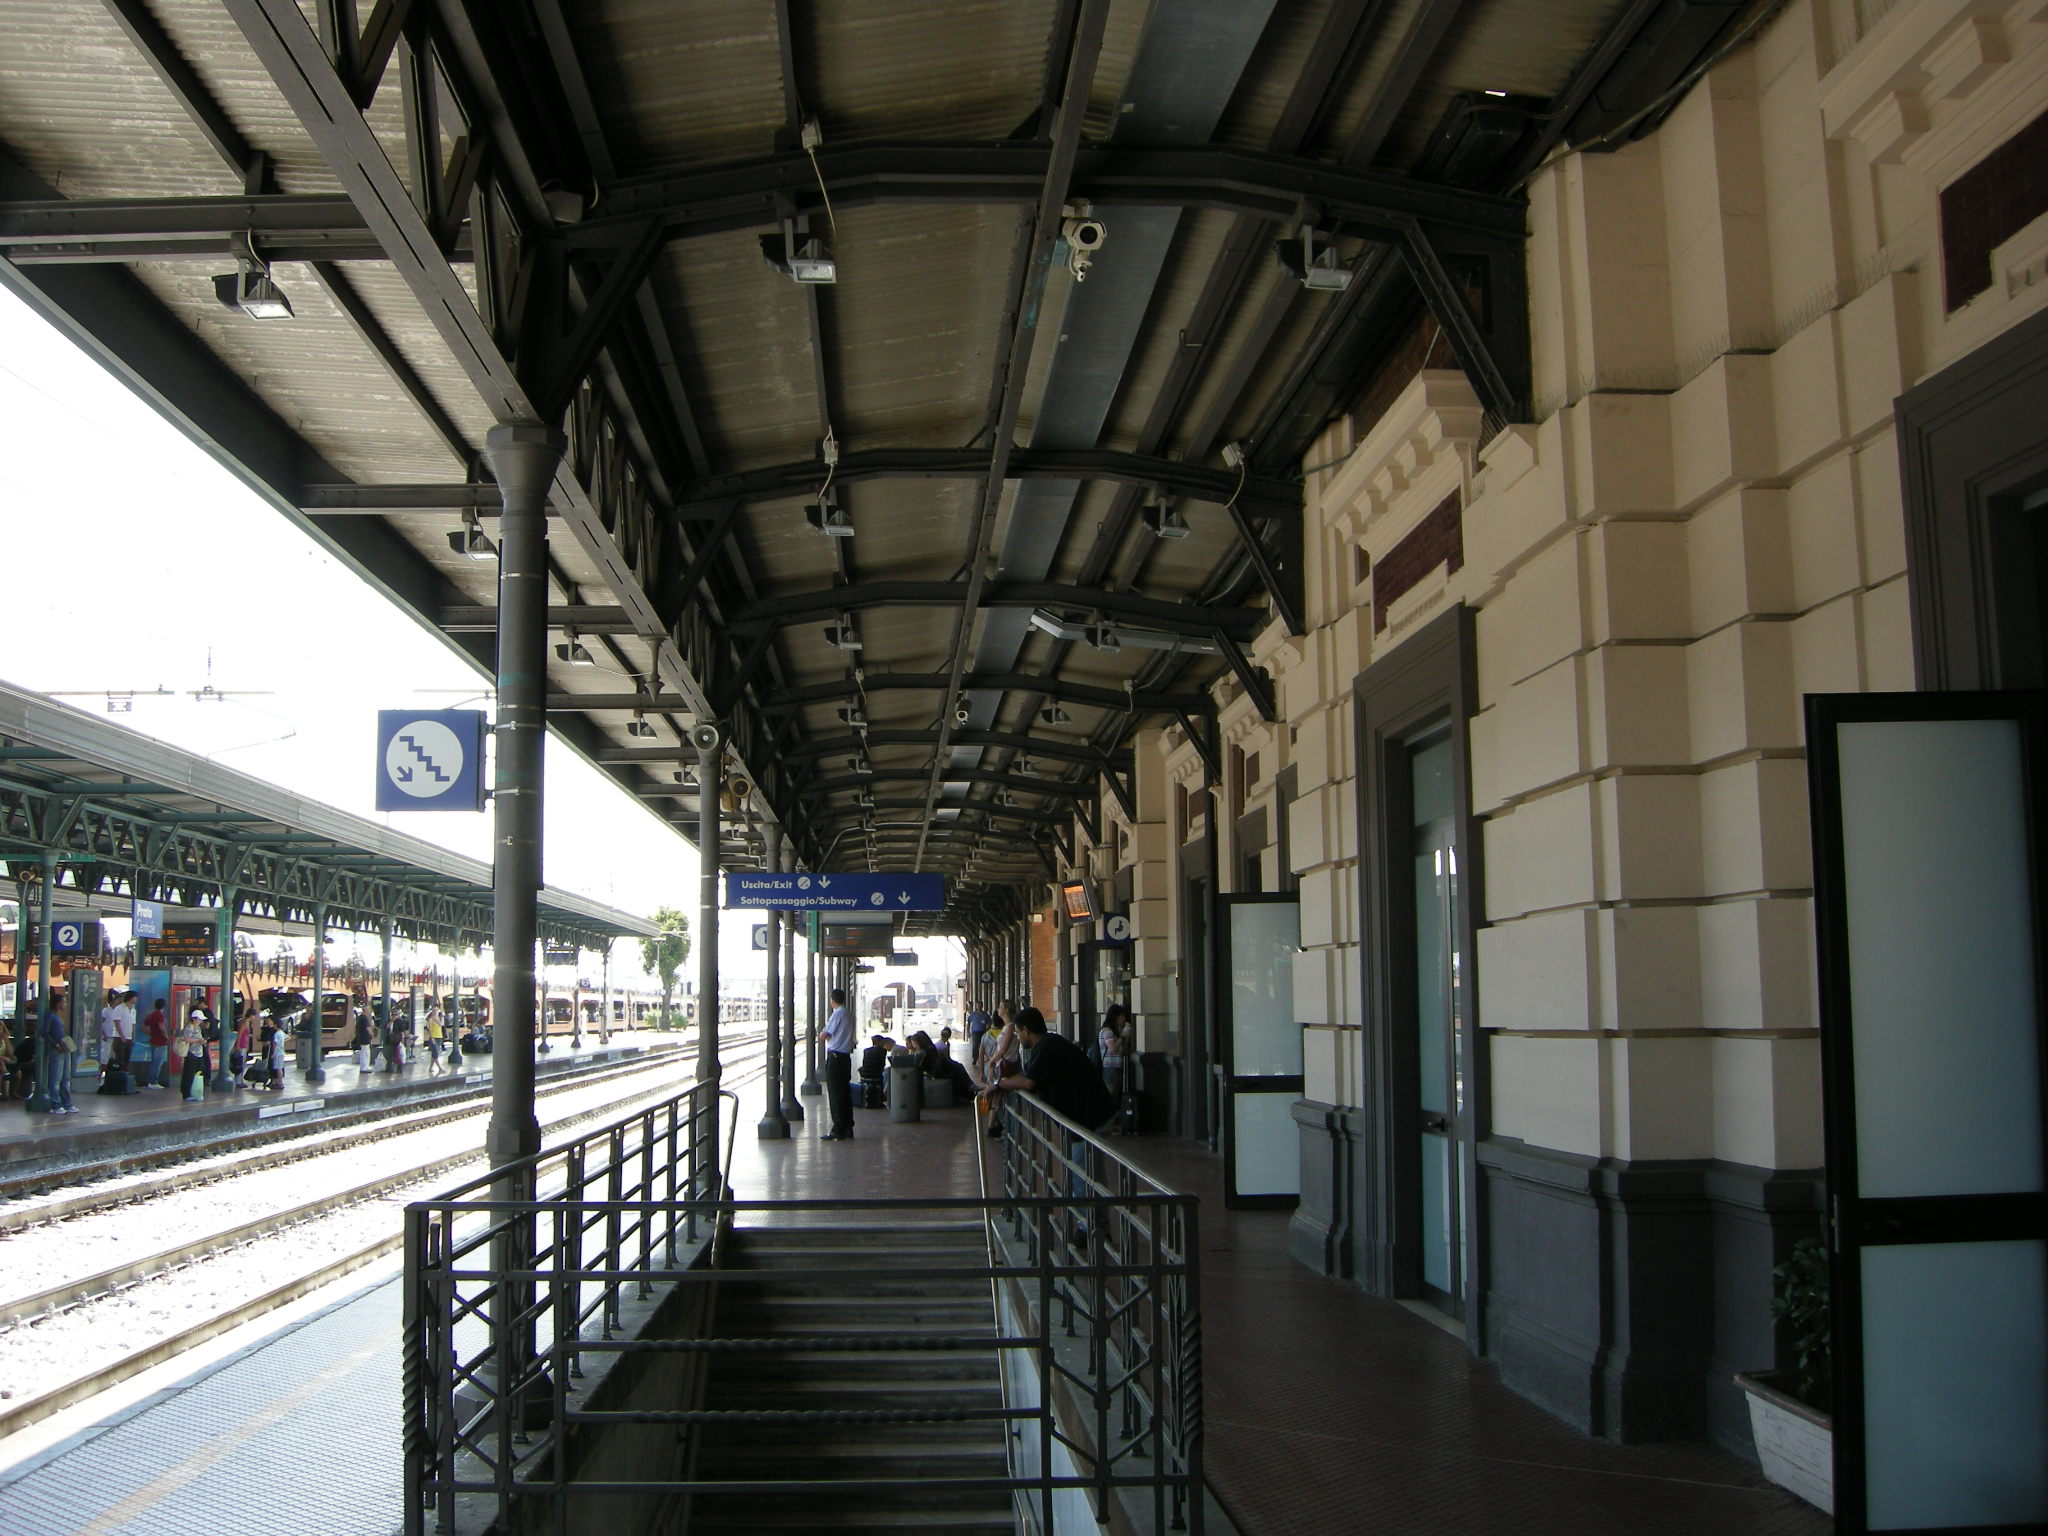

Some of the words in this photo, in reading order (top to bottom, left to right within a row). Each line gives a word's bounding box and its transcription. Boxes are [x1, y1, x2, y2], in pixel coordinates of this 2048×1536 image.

[741, 880, 792, 889] Uscita/Exit
[740, 896, 857, 906] Sottopassaggio/Subway
[137, 904, 153, 919] Prato
[33, 926, 40, 934] 3
[203, 927, 210, 935] 2
[63, 929, 74, 942] 2
